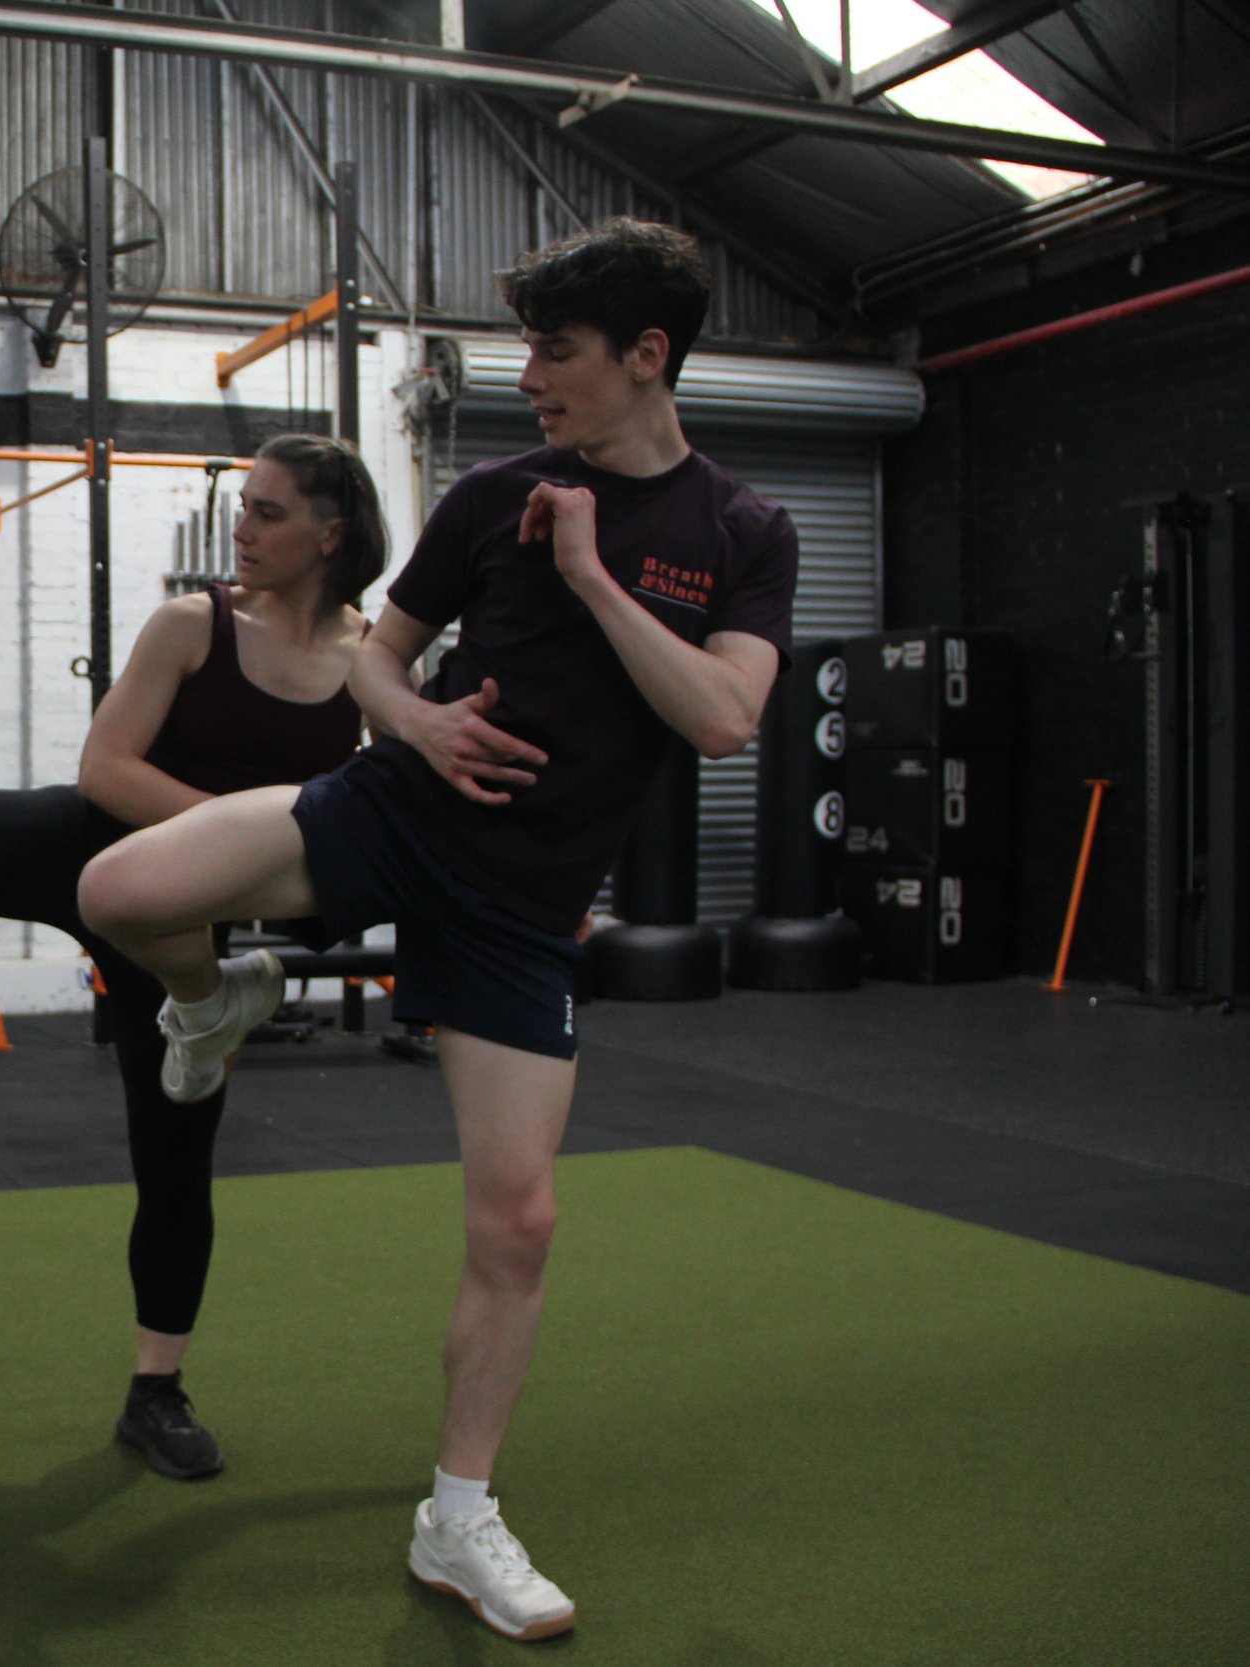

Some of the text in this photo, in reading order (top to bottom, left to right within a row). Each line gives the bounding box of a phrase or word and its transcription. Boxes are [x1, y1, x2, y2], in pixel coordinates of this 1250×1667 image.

[881, 640, 927, 671] 24
[827, 662, 845, 697] 2
[827, 719, 843, 753] 5
